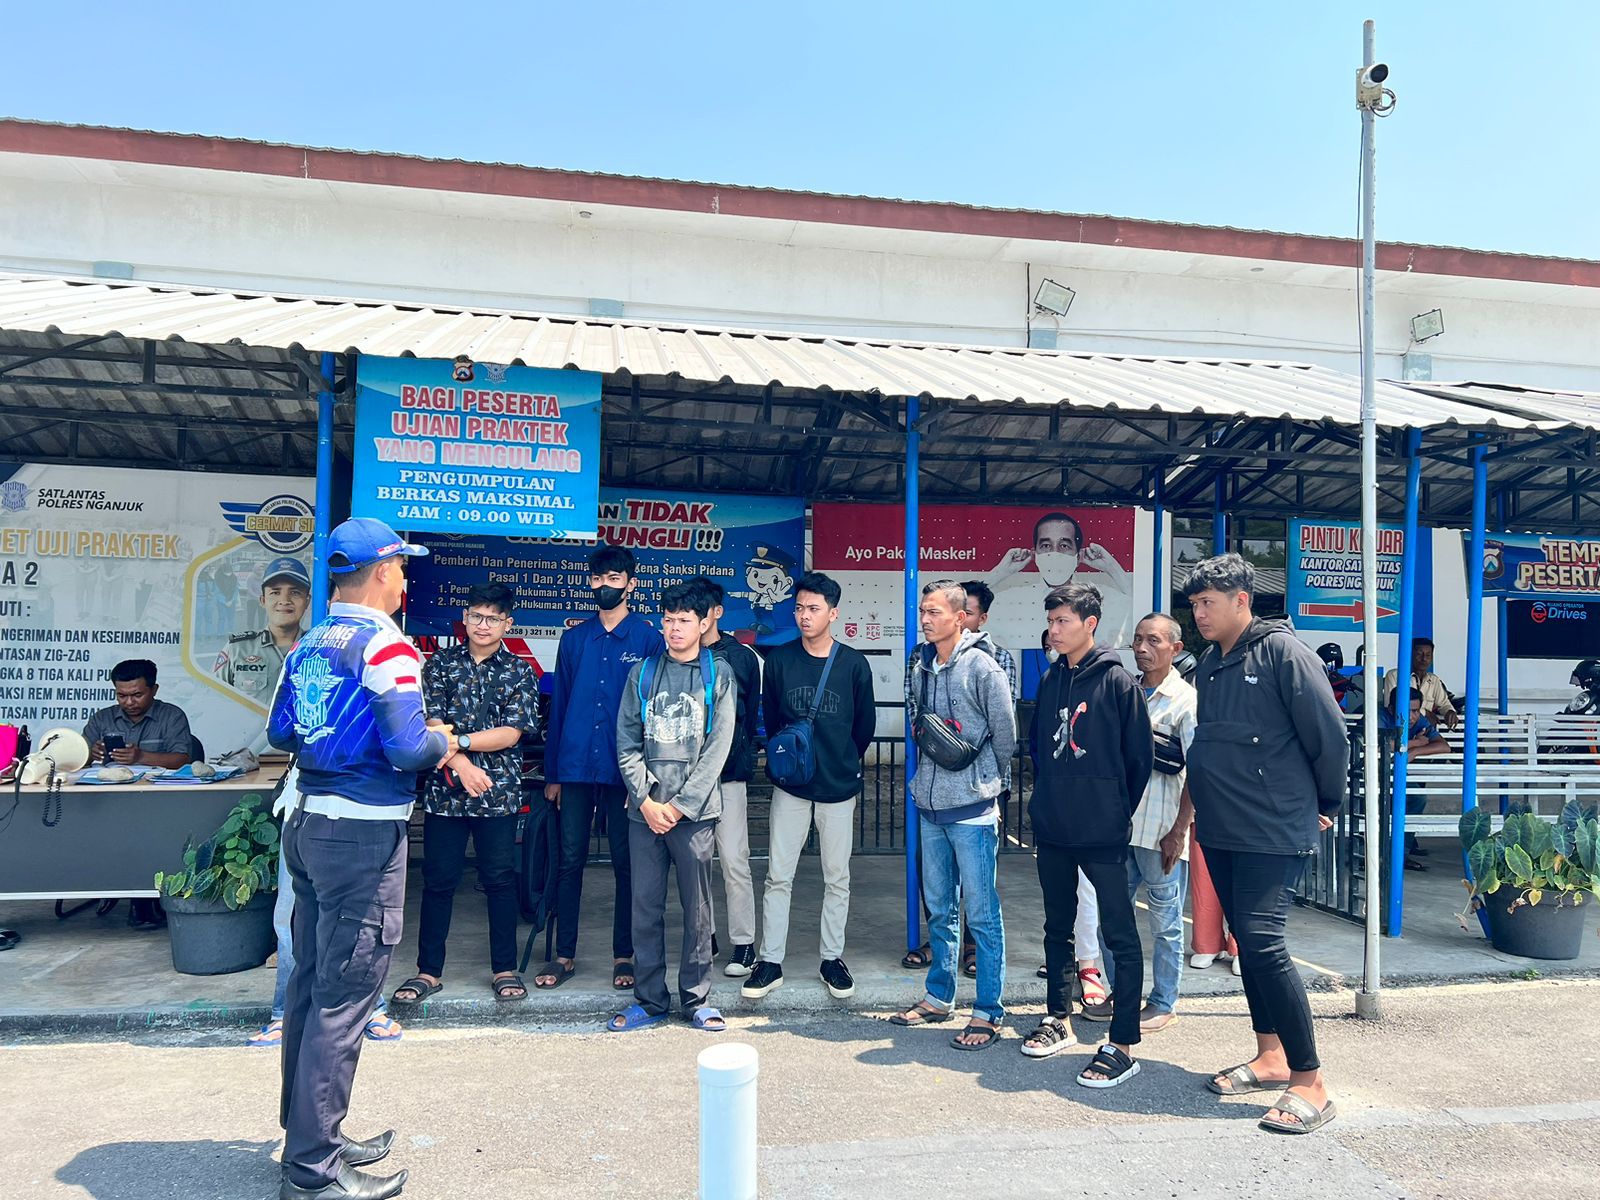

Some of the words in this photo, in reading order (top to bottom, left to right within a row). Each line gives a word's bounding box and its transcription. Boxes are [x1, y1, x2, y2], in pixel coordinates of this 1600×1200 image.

[402, 385, 455, 411] BAGI
[462, 389, 561, 417] PESERTA
[392, 412, 461, 438] UJIAN
[467, 416, 569, 444] PRAKTEK
[374, 438, 436, 464] YANG
[441, 442, 581, 473] MENGULANG
[399, 469, 556, 491] PENGUMPULAN
[38, 488, 106, 500] SATLANTAS
[377, 486, 461, 504] BERKAS
[466, 490, 575, 510] MAKSIMAL
[37, 499, 83, 509] POLRES
[85, 500, 144, 512] NGANJUK
[626, 500, 712, 524] TIDAK
[247, 515, 298, 531] CERMAT
[397, 505, 440, 520] JAM
[458, 508, 511, 523] 09.00
[516, 511, 555, 525] WIB
[0, 529, 31, 554] ET
[36, 530, 70, 556] UJI
[75, 531, 180, 559] PRAKTEK
[1300, 524, 1345, 551] PINTU
[1348, 527, 1404, 555] KUAR
[845, 545, 873, 562] Ayo
[919, 546, 976, 560] Masker!
[434, 554, 479, 567] Pemberi
[482, 556, 503, 568] Dan
[507, 557, 557, 569] Penerima
[561, 559, 590, 571] Sama
[663, 564, 697, 575] Sanksi
[700, 565, 735, 576] Pidana
[1300, 557, 1345, 571] KANTOR
[1344, 559, 1401, 574] SATNTAS
[25, 562, 38, 586] 2
[489, 571, 519, 583] Pasal
[522, 573, 528, 583] 1
[533, 573, 553, 585] Dan
[556, 574, 564, 585] 2
[567, 574, 582, 585] UU
[1305, 574, 1345, 587] POLRES
[1345, 576, 1395, 590] NGJUK
[1520, 563, 1600, 588] PESERT
[439, 585, 447, 593] 1.
[450, 584, 472, 594] Pem
[516, 587, 558, 597] Hukuman
[560, 589, 566, 598] 5
[569, 589, 595, 599] Tahun
[633, 591, 648, 602] Rp.
[438, 597, 447, 606] 2.
[521, 600, 563, 610] Hukuman
[565, 602, 571, 610] 3
[574, 601, 600, 611] Tahun
[638, 604, 652, 614] Rp.
[1548, 607, 1588, 620] Drives
[0, 628, 61, 643] NGERIMAN
[65, 629, 89, 643] DAN
[91, 630, 180, 645] KESEIMBANGAN
[44, 648, 90, 662] ZIG-ZAG
[26, 668, 34, 681] 8
[38, 668, 64, 681] TIGA
[67, 668, 93, 682] KALI
[97, 669, 112, 682] PU
[28, 687, 54, 700] REM
[56, 687, 117, 701] MENGHIND
[41, 707, 78, 720] PUTAR
